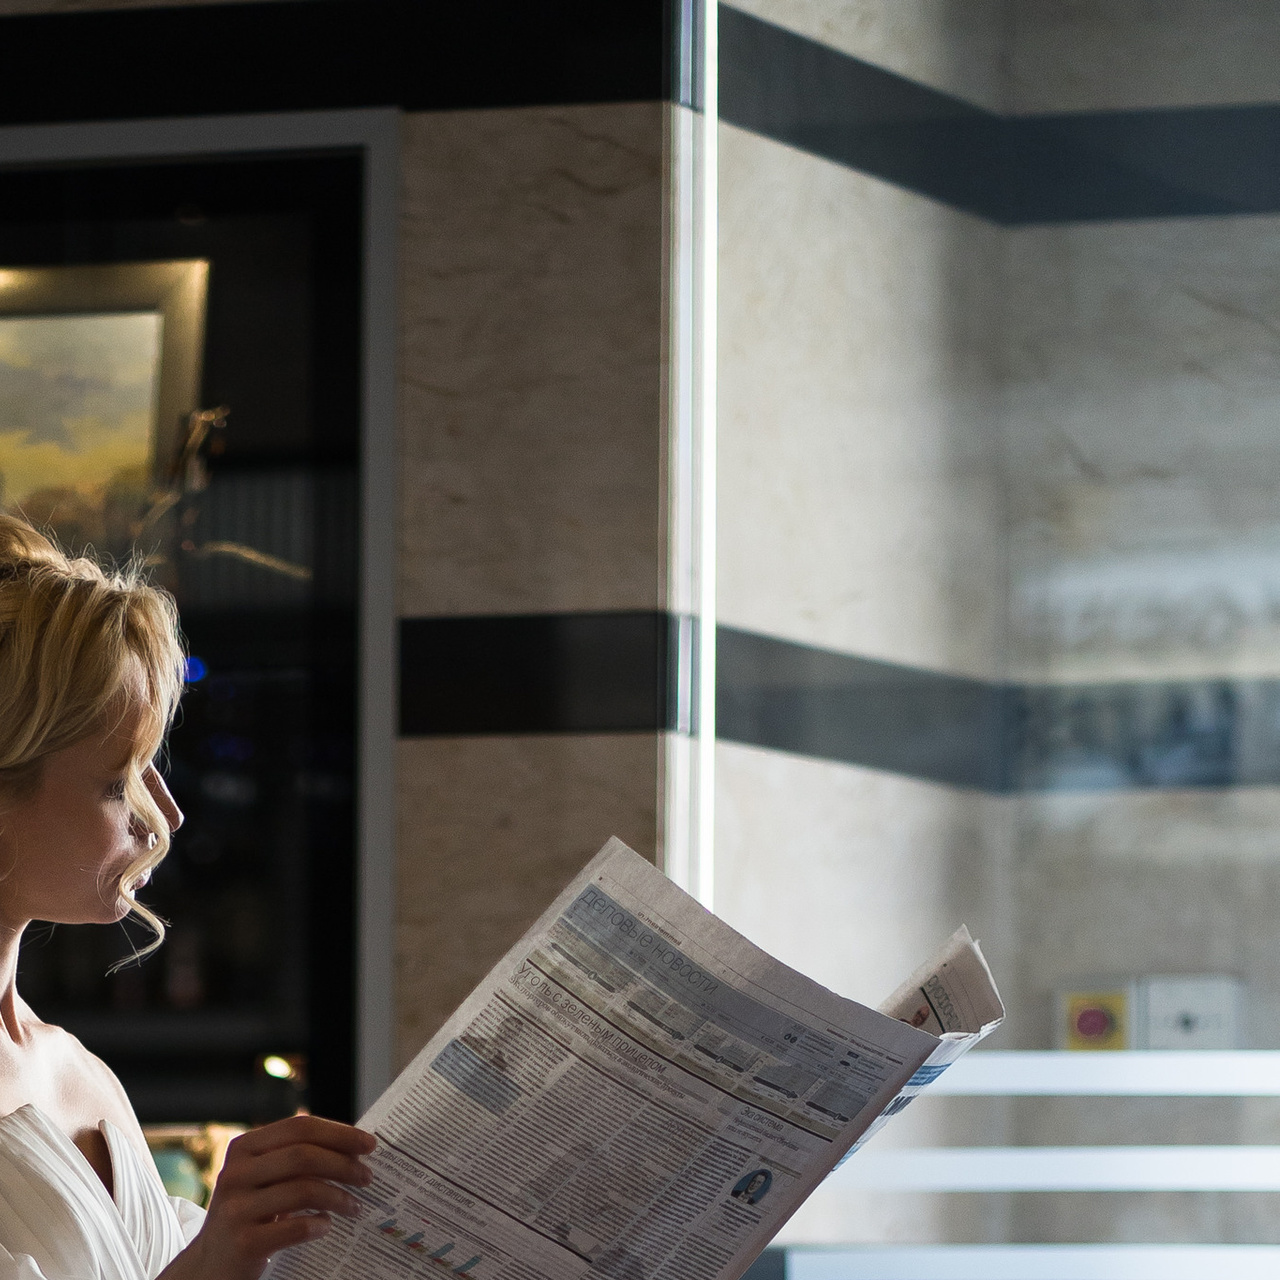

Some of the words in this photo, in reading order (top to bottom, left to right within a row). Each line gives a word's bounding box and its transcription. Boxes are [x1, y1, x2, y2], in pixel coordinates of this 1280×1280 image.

[653, 943, 718, 995] новости
[518, 962, 551, 997] Уголь
[552, 992, 563, 1002] с
[560, 998, 614, 1040] зеленым
[610, 1036, 667, 1074] прицепом
[395, 1158, 427, 1181] держат
[425, 1176, 475, 1208] дистанцию
